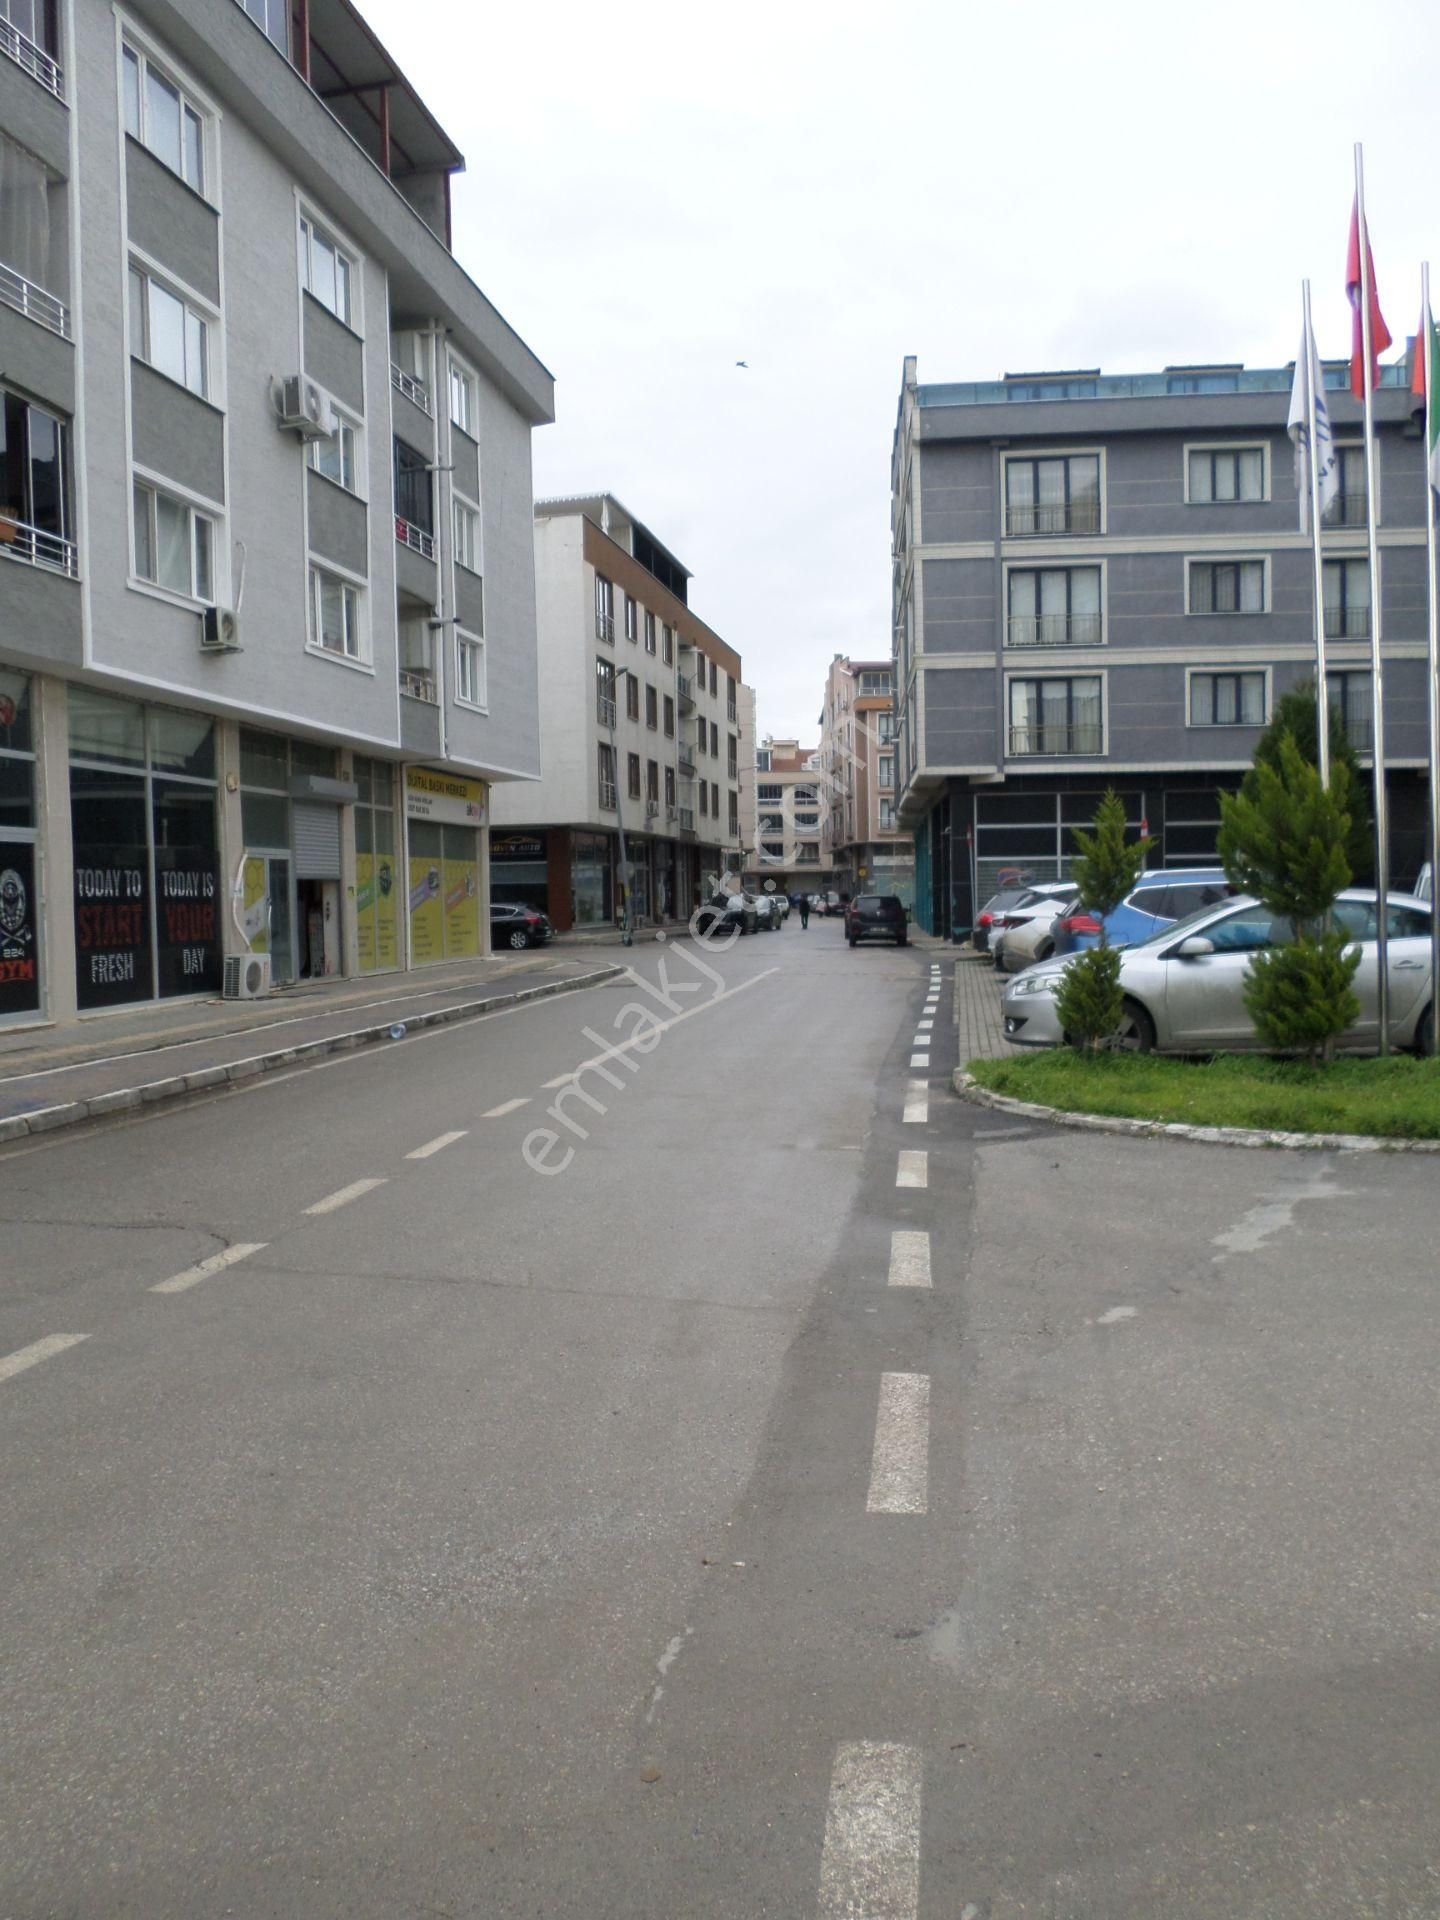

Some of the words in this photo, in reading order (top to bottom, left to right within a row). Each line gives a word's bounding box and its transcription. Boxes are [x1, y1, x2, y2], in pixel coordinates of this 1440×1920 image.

[76, 868, 121, 897] TODAY
[124, 870, 142, 897] TO
[162, 870, 200, 897] TODAY
[202, 872, 214, 897] IS
[78, 904, 143, 948] START
[166, 903, 214, 943] YOUR
[90, 953, 134, 984] FRESH
[183, 948, 205, 975] DAY
